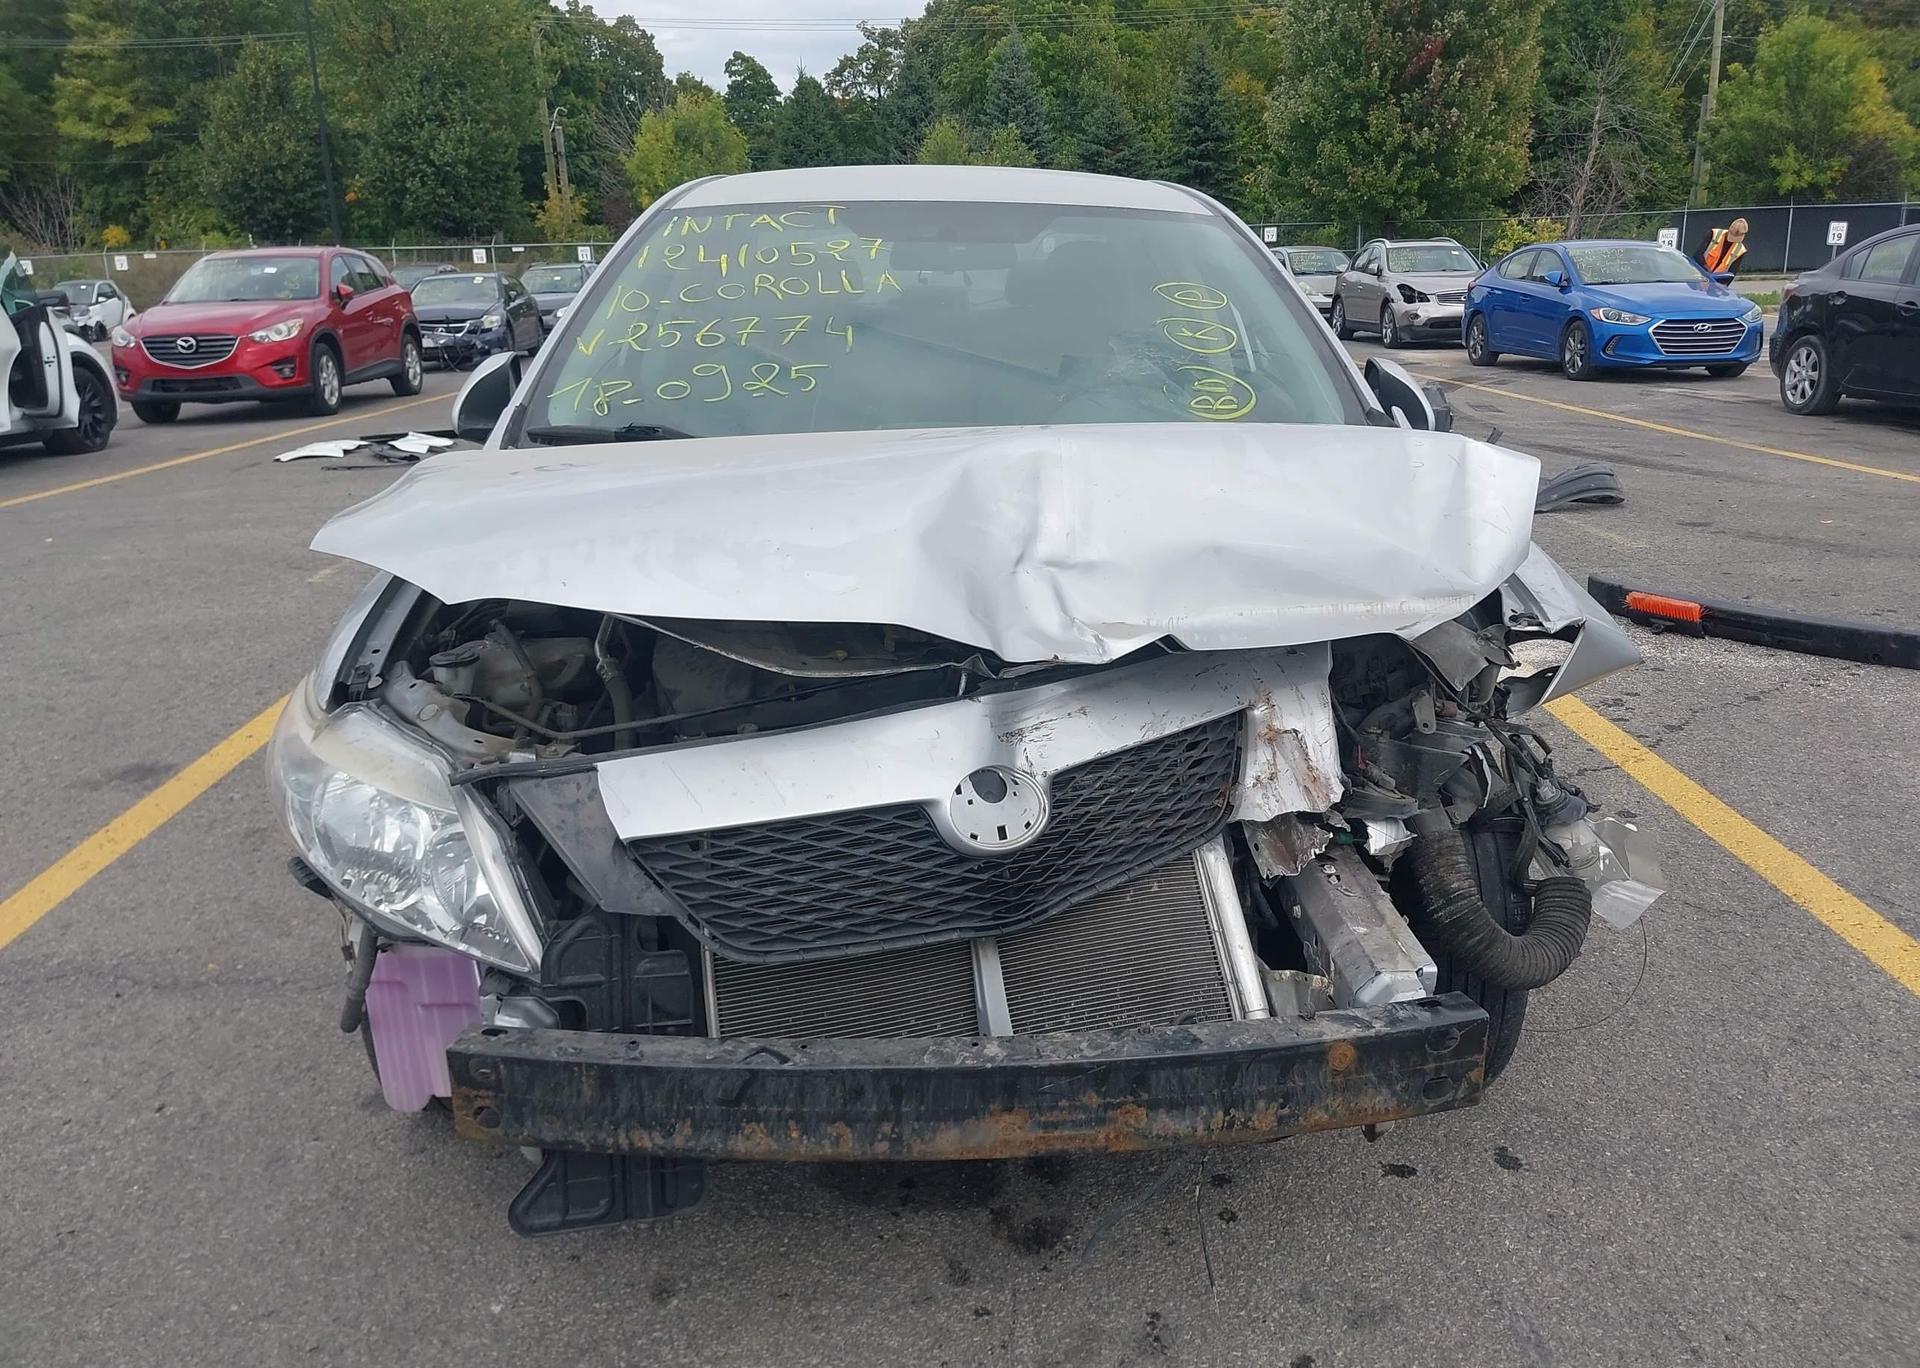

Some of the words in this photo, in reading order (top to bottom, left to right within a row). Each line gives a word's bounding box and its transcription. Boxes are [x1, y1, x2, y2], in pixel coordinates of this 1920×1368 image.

[663, 205, 847, 237] INTACT
[1831, 232, 1842, 241] 19
[637, 238, 885, 277] 12410527
